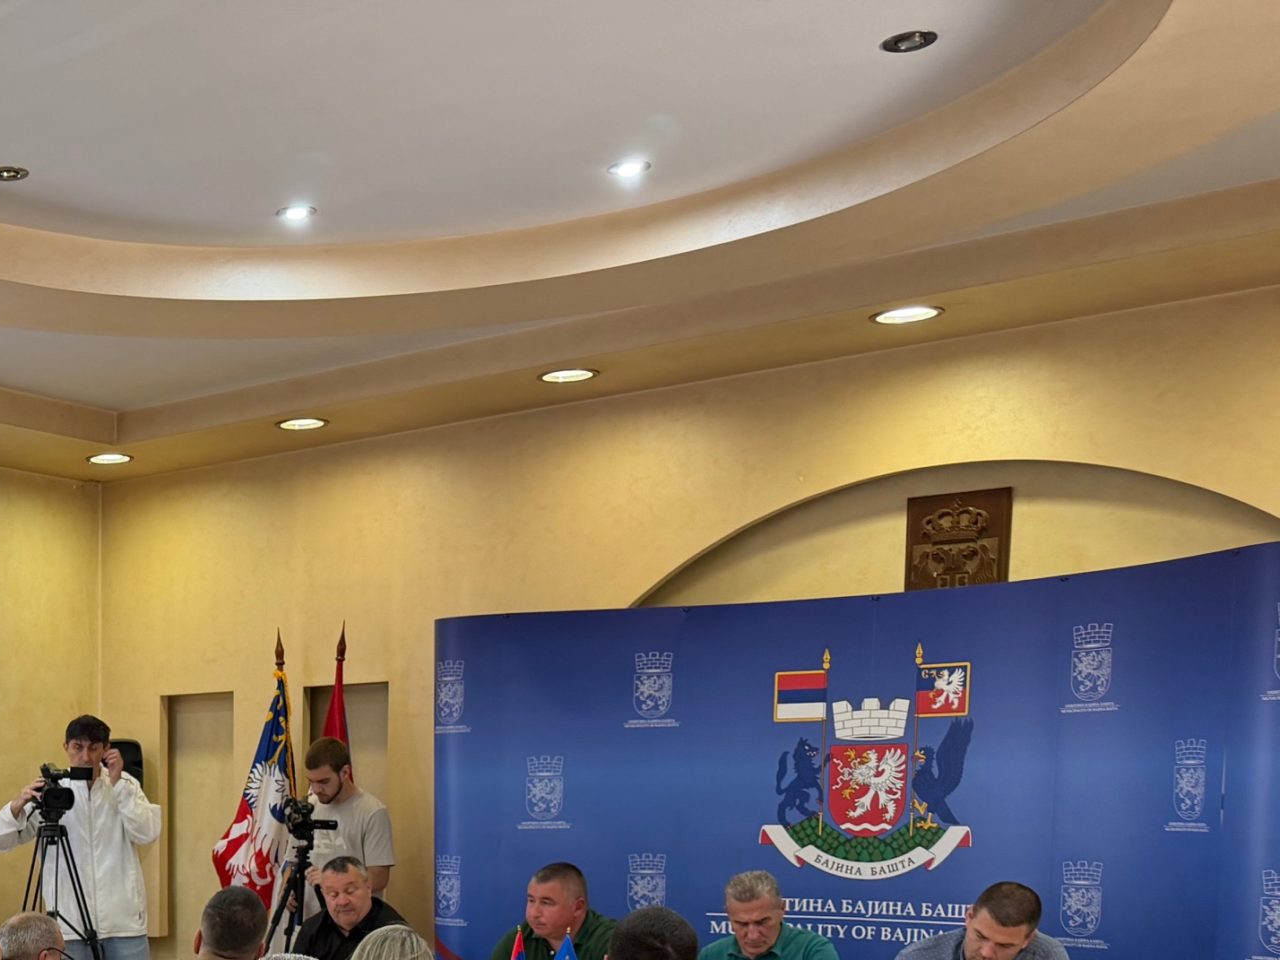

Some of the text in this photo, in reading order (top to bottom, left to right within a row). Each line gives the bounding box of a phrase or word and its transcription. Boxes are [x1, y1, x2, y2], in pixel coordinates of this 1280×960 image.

[813, 854, 916, 876] БАЈИНА БАШТА
[782, 897, 972, 918] ТИНА БАЈИНА БАШ
[851, 925, 877, 940] OF
[880, 926, 945, 945] BAJIN
